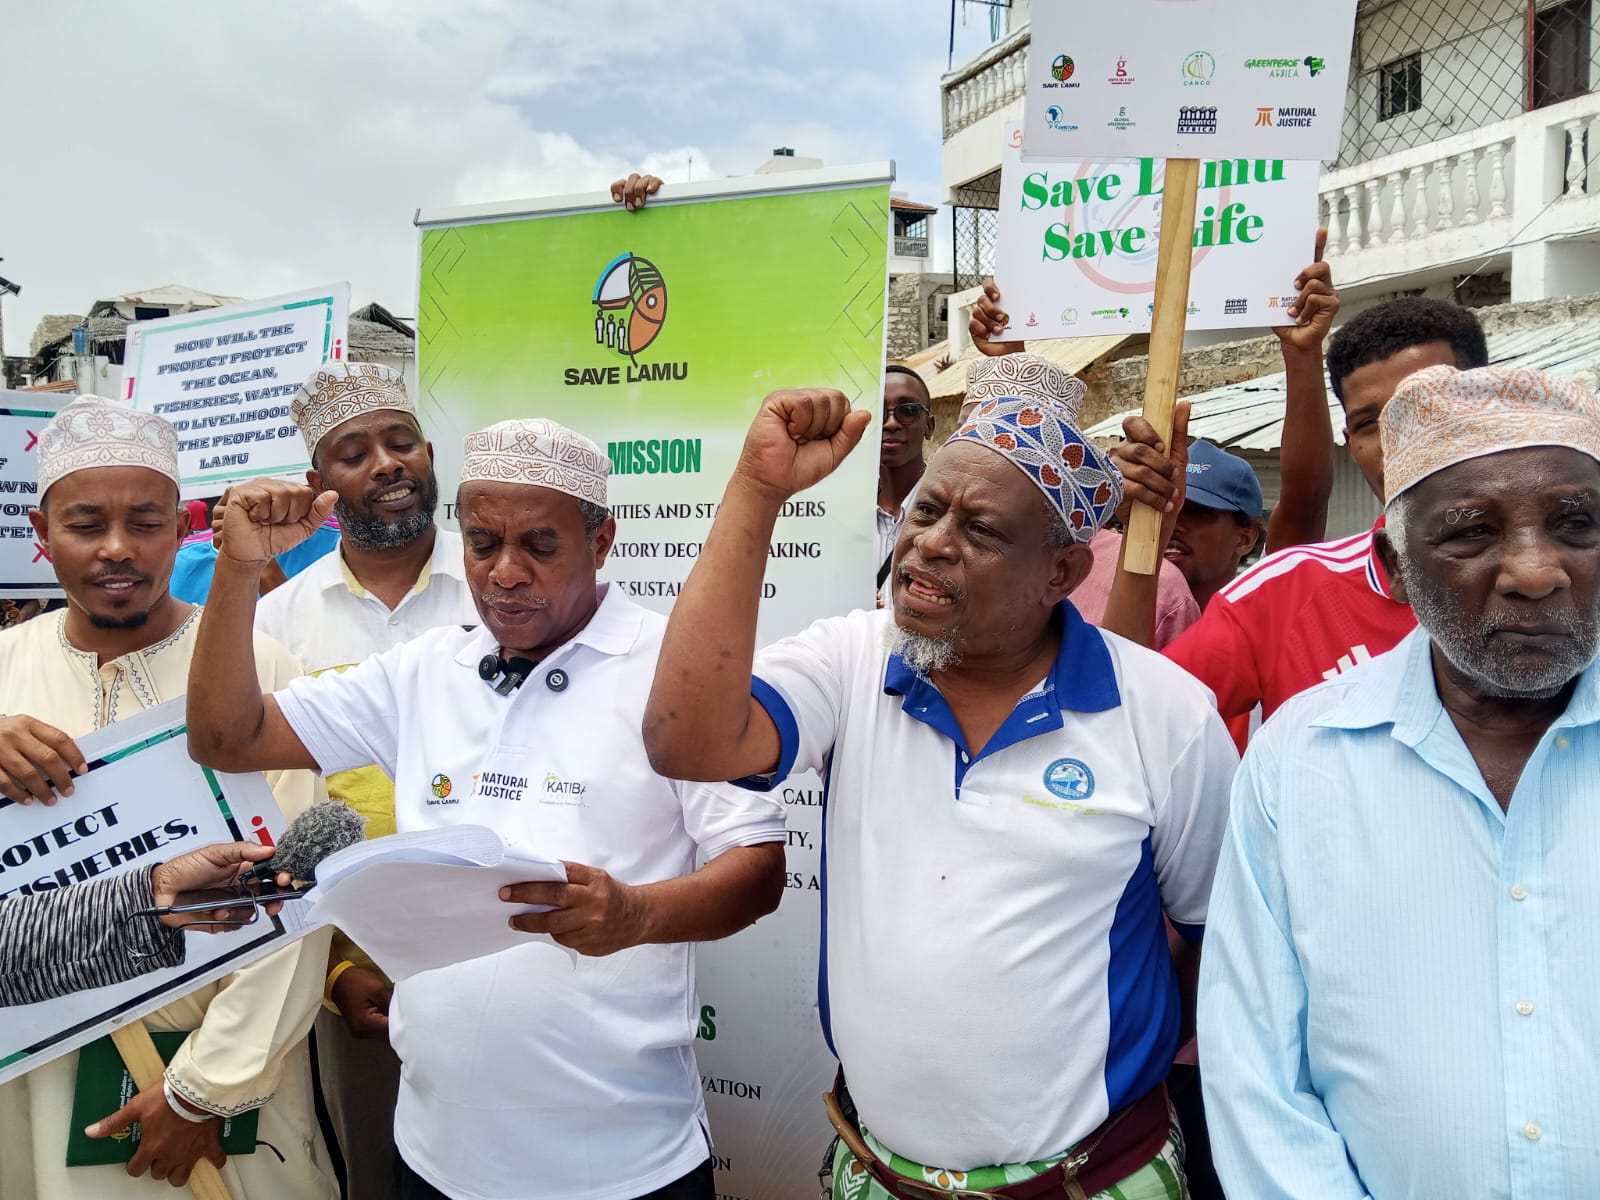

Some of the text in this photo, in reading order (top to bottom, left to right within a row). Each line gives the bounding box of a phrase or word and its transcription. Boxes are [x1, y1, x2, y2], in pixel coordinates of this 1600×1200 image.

[1244, 58, 1300, 70] GREENPEACE
[1277, 118, 1312, 127] JUSTICE
[1278, 107, 1317, 117] NATURAL
[1021, 157, 1286, 212] Save Lmu
[1042, 202, 1264, 262] Save ife
[174, 323, 295, 354] HOW WILL THE
[157, 341, 308, 376] PROJECT PROTECT
[181, 366, 278, 391] THE OCEAN,
[564, 362, 688, 385] SAVE LAMU
[153, 392, 243, 414] FISHERIES,
[178, 426, 298, 452] THE PEOPLE OF
[199, 453, 250, 470] LAMU
[607, 438, 702, 475] MISSION
[655, 503, 691, 519] AND
[481, 772, 528, 789] NATURAL
[479, 785, 523, 801] JUSTICE
[0, 802, 119, 873] OTECT
